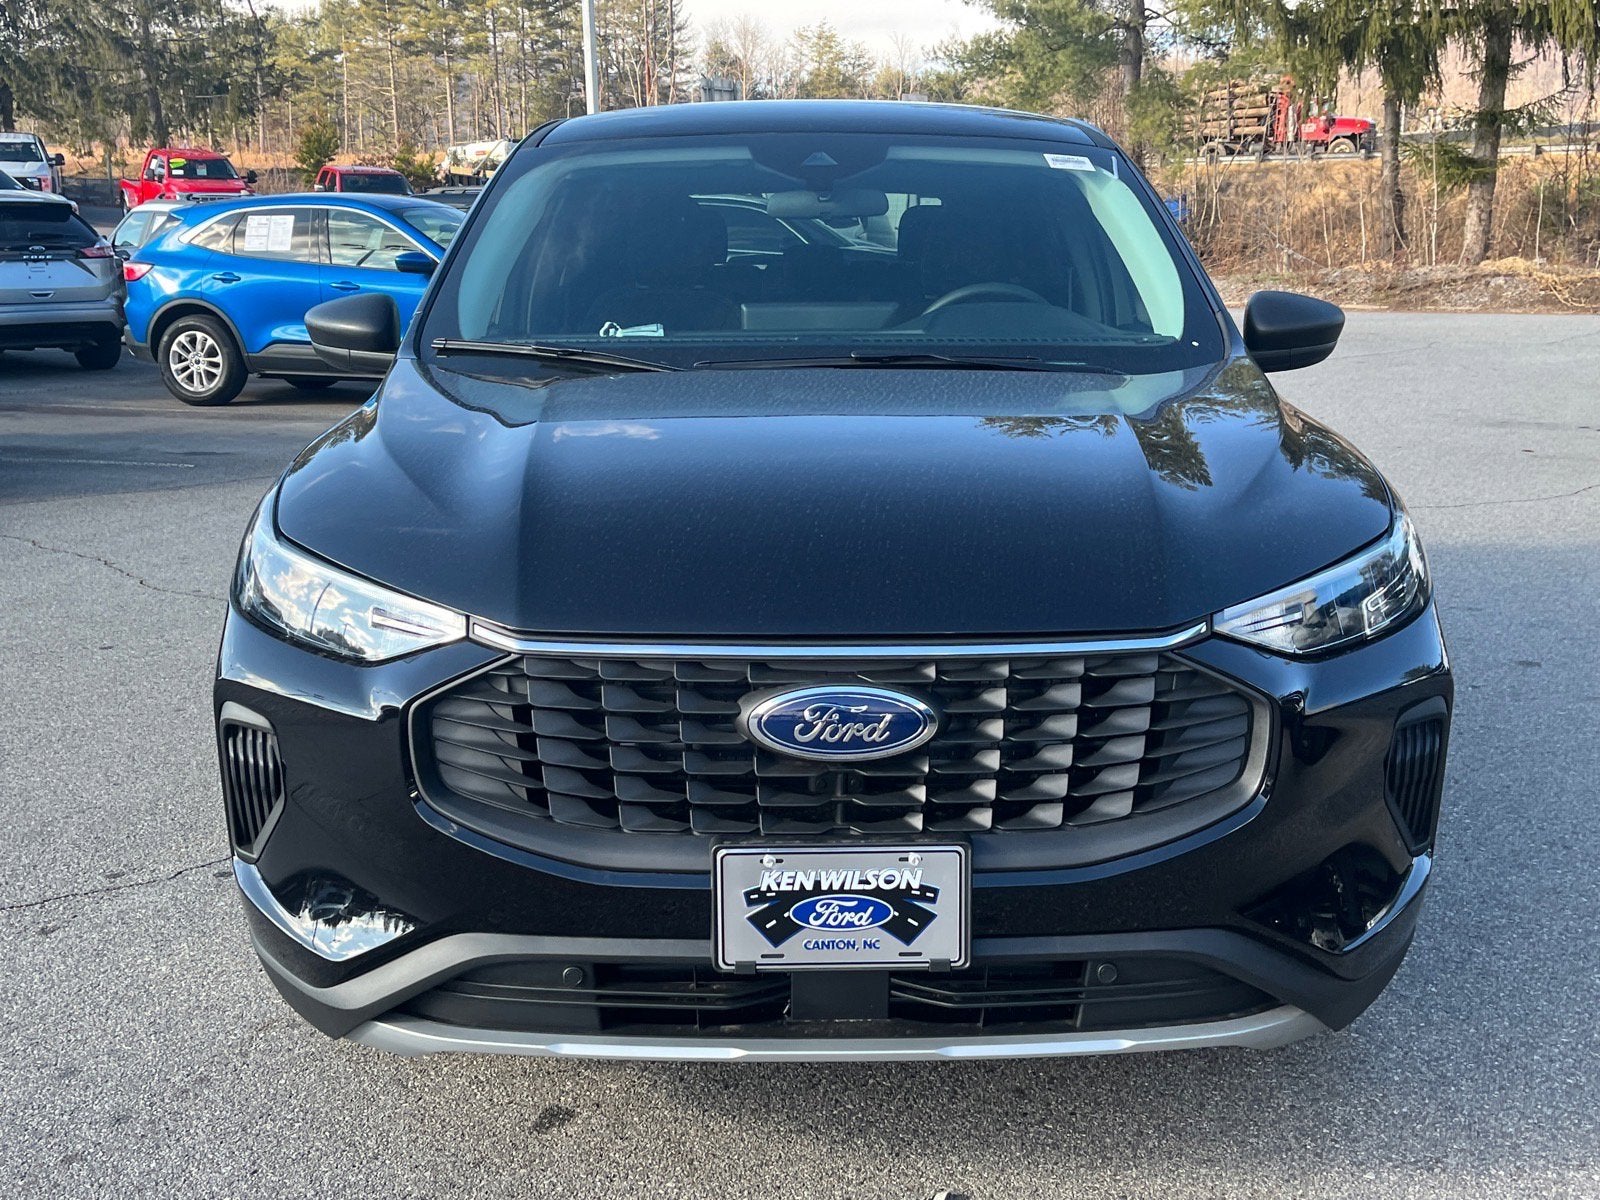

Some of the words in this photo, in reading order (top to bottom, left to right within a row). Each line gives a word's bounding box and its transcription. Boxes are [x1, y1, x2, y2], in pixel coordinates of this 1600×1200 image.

[794, 703, 892, 742] Ford
[760, 869, 816, 891] KEN
[819, 868, 923, 890] WILSON
[809, 900, 874, 926] Ford
[804, 939, 859, 951] CANTON,
[863, 939, 880, 949] NC
